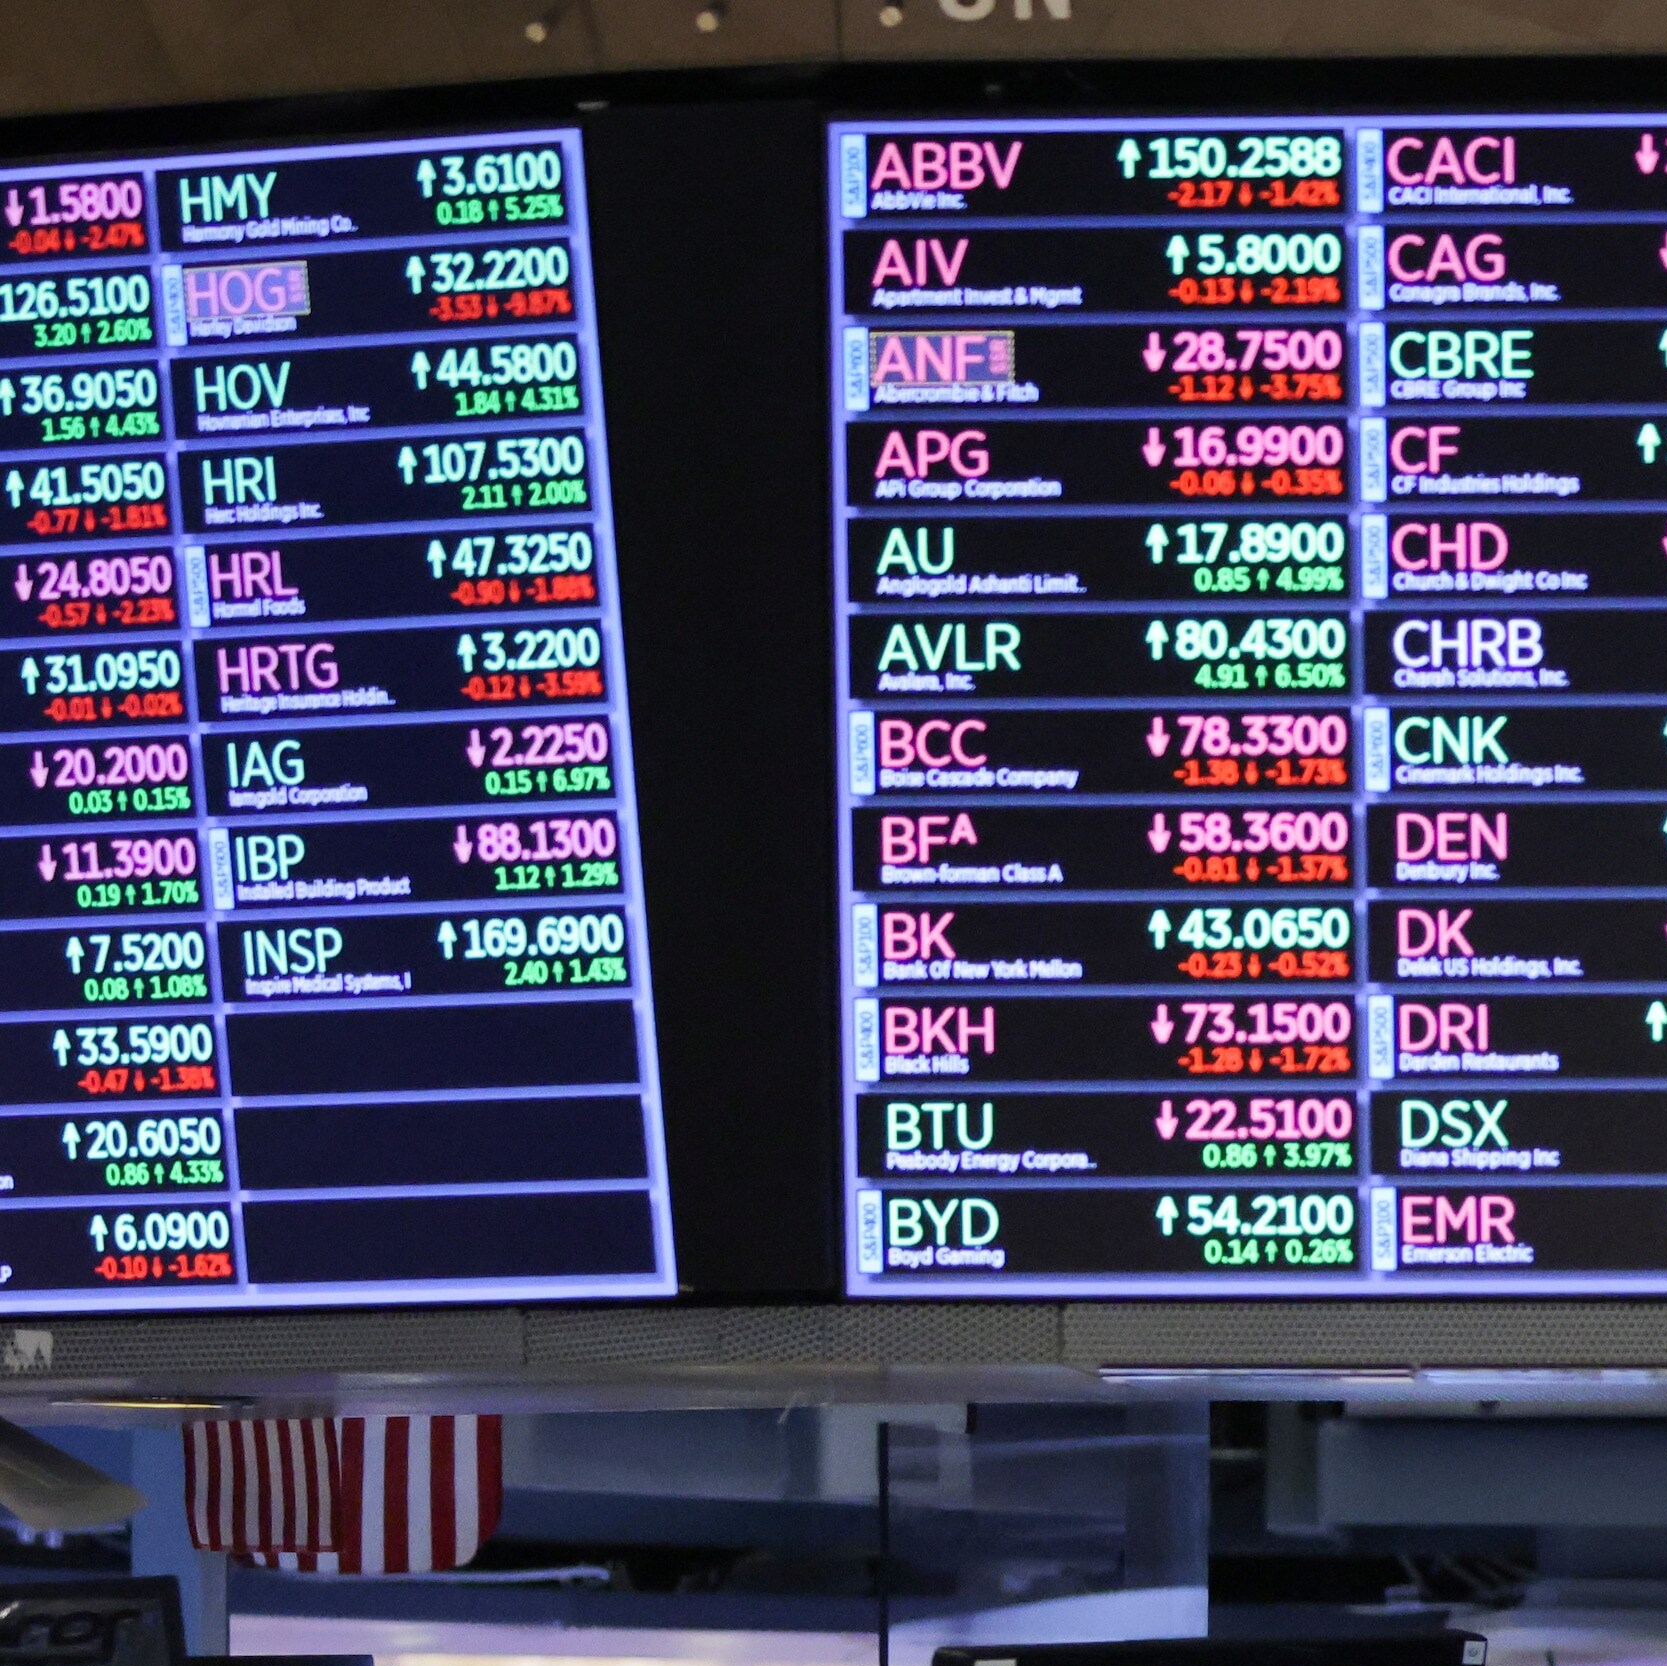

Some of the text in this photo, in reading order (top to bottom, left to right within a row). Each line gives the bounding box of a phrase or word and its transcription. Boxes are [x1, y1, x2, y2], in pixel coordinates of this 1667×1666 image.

[441, 150, 561, 193] 3.6100
[870, 141, 1023, 190] ABBV
[1148, 136, 1342, 177] 150.2588
[1386, 136, 1516, 186] CACI
[179, 171, 279, 223] HMY
[871, 238, 969, 286] AIV
[1197, 233, 1342, 273] 5.8000
[876, 336, 985, 382] ANF
[1172, 329, 1343, 369] 28.7500
[1389, 329, 1535, 378] CBRE
[423, 435, 585, 483] 107.5300
[874, 429, 990, 478] APG
[1173, 424, 1344, 466] 16.9900
[451, 531, 593, 575] 47.3250
[876, 526, 954, 574] AU
[1176, 521, 1345, 562] 17.8900
[1390, 521, 1509, 571] CHD
[877, 622, 1021, 671] AVLR
[1174, 618, 1346, 658] 80.4300
[1392, 618, 1544, 667] CHRB
[879, 719, 988, 767] BCC
[1177, 714, 1347, 754] 78.3300
[1394, 715, 1509, 763] CNK
[227, 739, 305, 788] IAG
[1179, 811, 1349, 850] 58.3600
[882, 911, 956, 959] BK
[1177, 907, 1350, 947] 43.0650
[243, 927, 343, 976] INSP
[884, 1005, 995, 1055] BKH
[1181, 1002, 1351, 1043] 73.1500
[1398, 1002, 1489, 1052] DRI
[886, 1102, 994, 1152] BTU
[1184, 1098, 1353, 1139] 22.5100
[114, 1210, 230, 1252] 6.0900
[888, 1197, 1000, 1248] BYD
[1186, 1194, 1354, 1235] 54.2100
[1401, 1194, 1516, 1245] EMR
